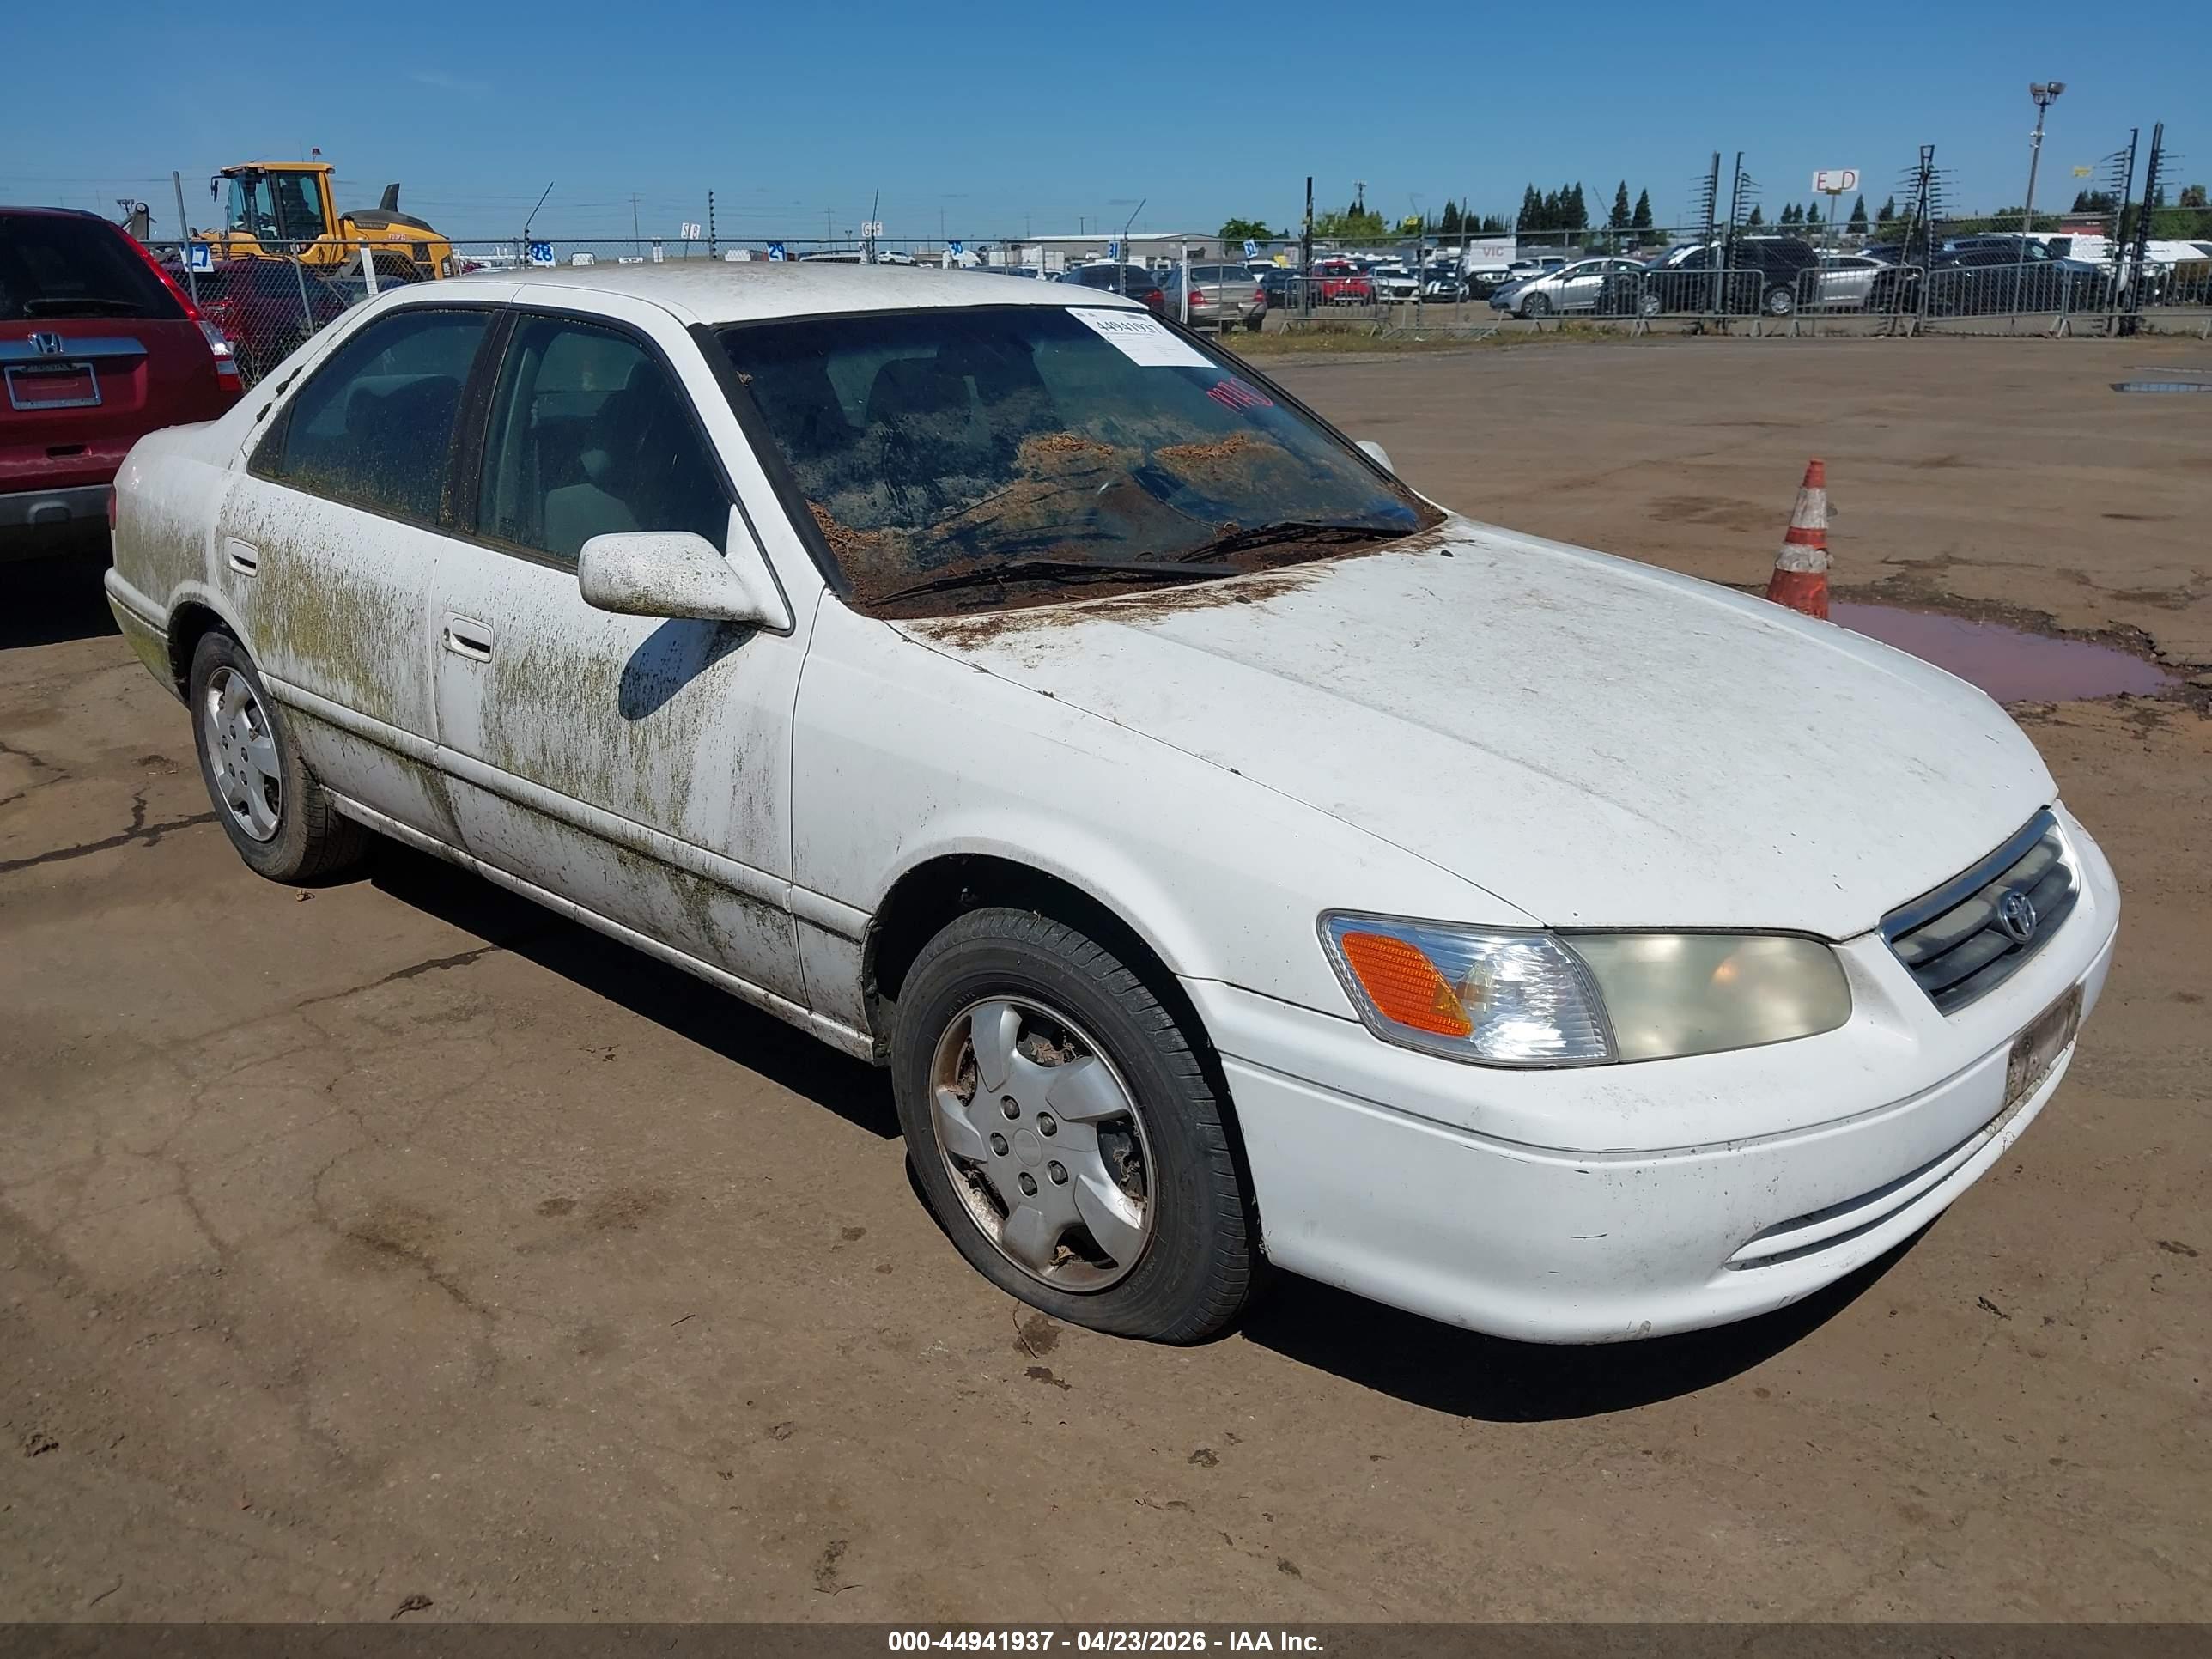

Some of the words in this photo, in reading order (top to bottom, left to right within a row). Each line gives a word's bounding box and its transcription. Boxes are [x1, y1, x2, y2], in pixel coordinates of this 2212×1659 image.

[1817, 172, 1828, 191] E
[1841, 171, 1856, 190] D
[531, 242, 553, 262] 28
[1096, 320, 1163, 335] 44941937
